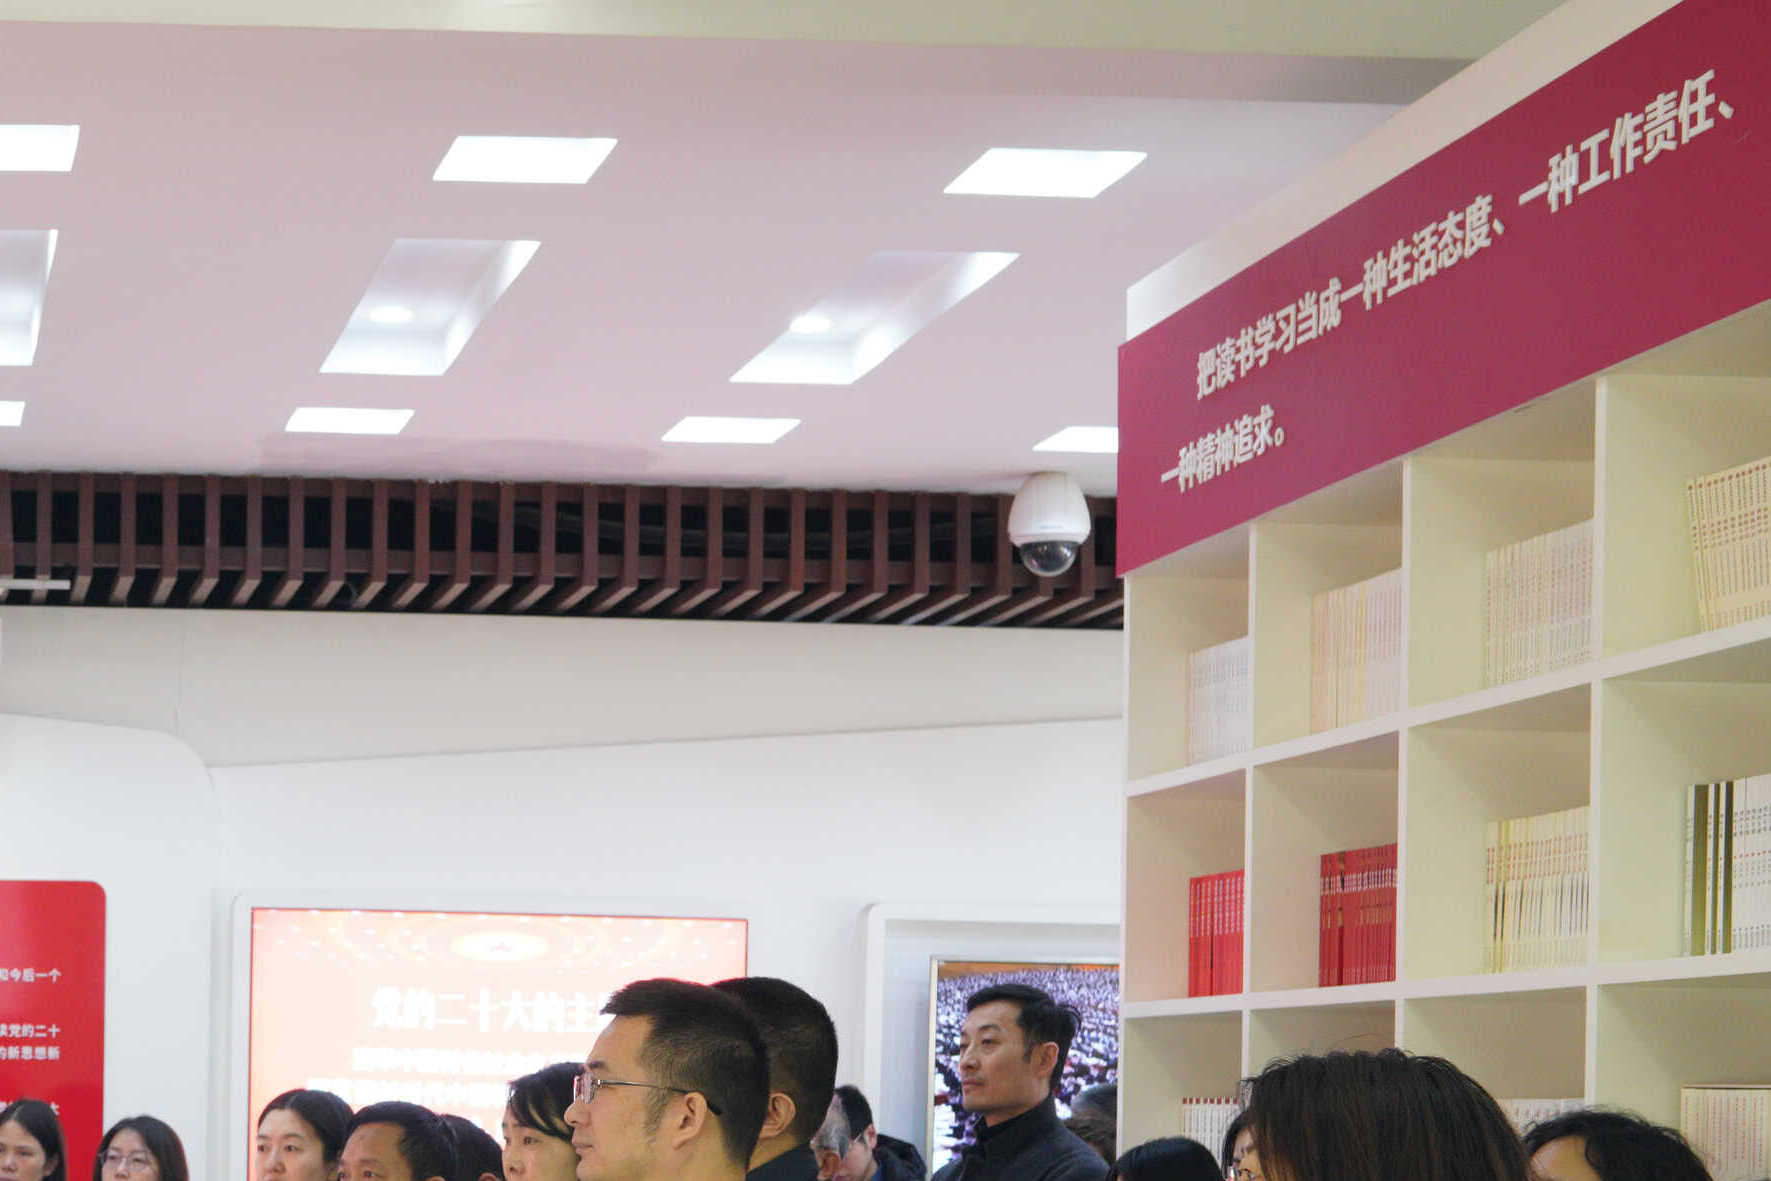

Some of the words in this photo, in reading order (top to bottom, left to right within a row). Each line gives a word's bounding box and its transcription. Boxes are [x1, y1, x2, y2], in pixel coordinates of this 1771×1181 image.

[1196, 70, 1734, 401] 把读书学习当成一种生活态度、一种工作责任、
[1160, 404, 1286, 495] 一种精神追求。
